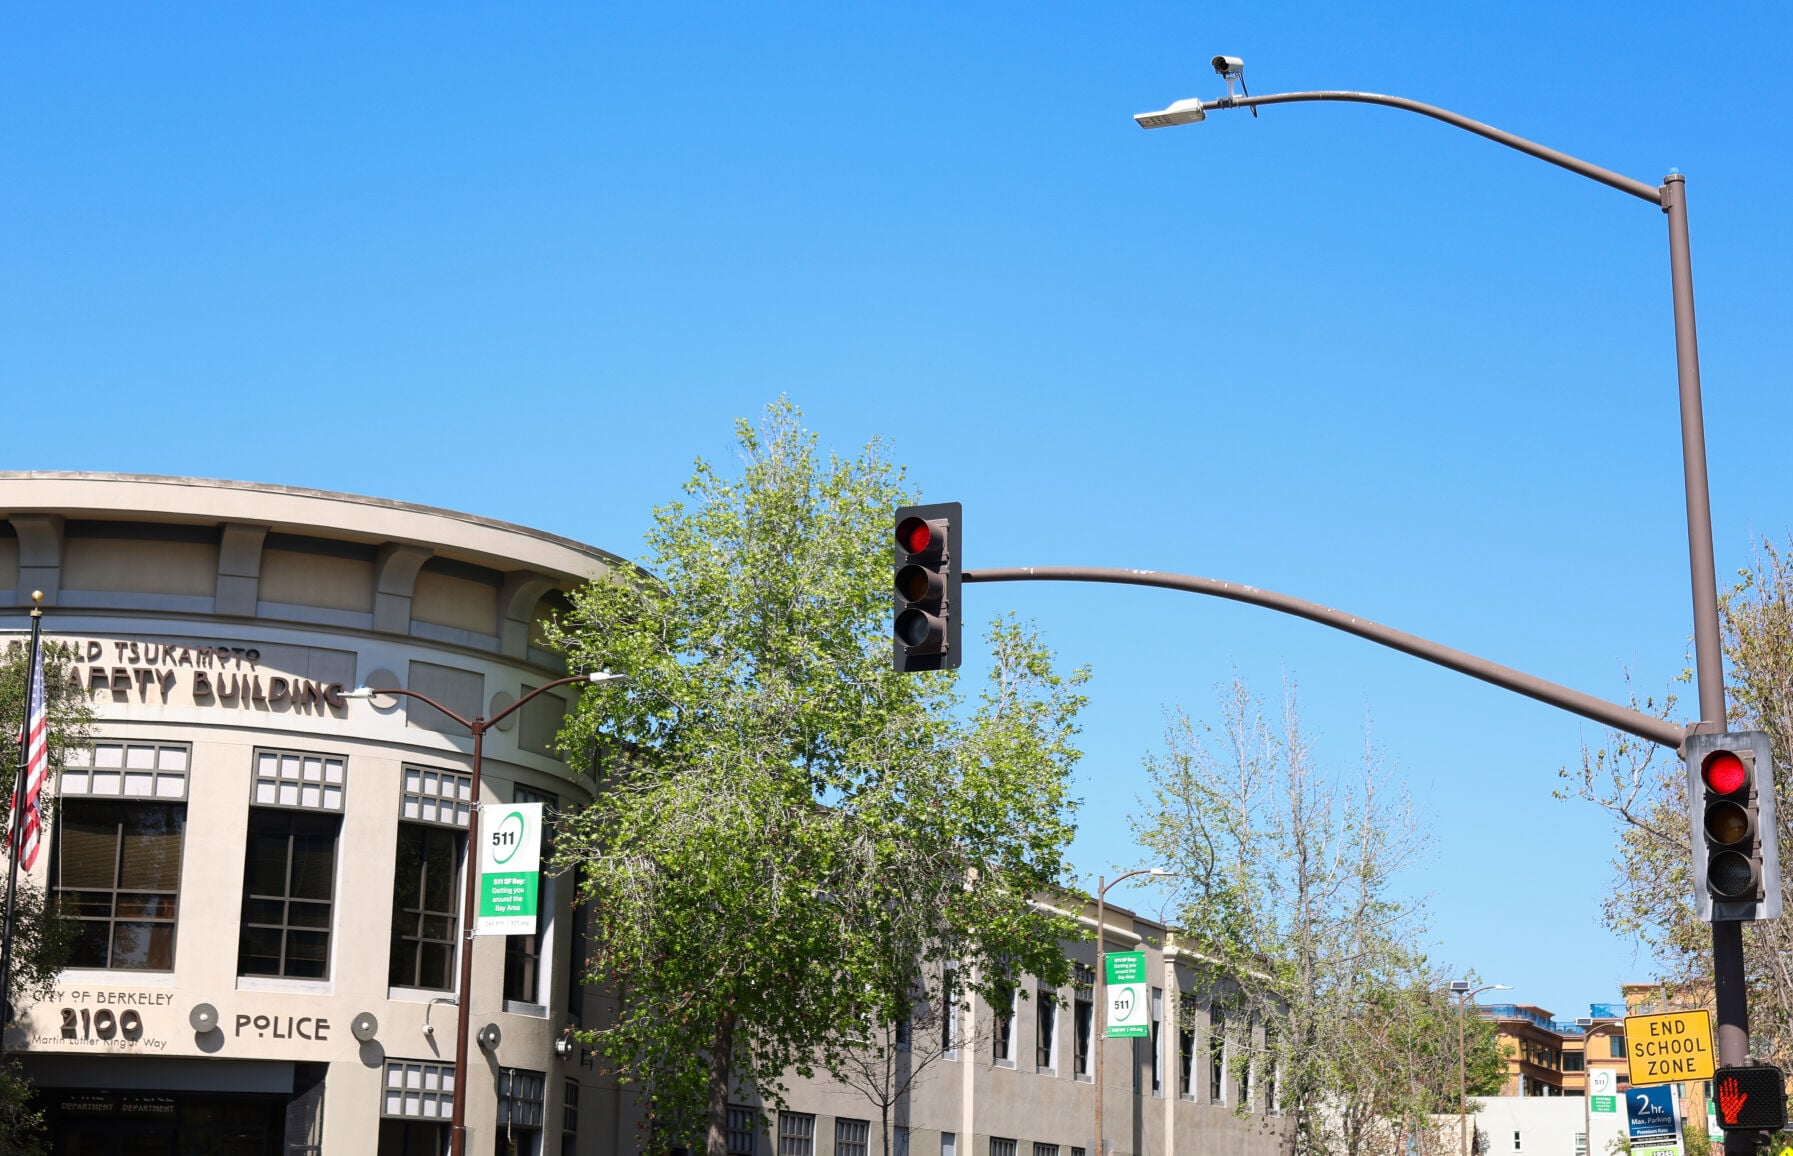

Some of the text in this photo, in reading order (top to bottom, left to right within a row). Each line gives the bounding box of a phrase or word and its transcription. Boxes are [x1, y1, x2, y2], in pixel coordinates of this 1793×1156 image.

[115, 641, 261, 671] TSUKAMOTO
[50, 666, 348, 709] AFETY BUILDING
[492, 831, 515, 846] 511
[71, 990, 91, 1003] OF
[97, 991, 174, 1006] BERKELEY
[1114, 1000, 1129, 1009] 511
[60, 1007, 142, 1034] 2100
[235, 1014, 331, 1041] POLICE
[1650, 1020, 1685, 1036] END
[31, 1036, 65, 1045] Martin
[69, 1036, 100, 1046] Luther
[103, 1037, 128, 1049] King
[143, 1038, 167, 1050] Way
[1635, 1037, 1706, 1057] SCHOOL
[1648, 1058, 1696, 1076] ZONE
[1636, 1094, 1665, 1116] 2 hr.
[1631, 1116, 1672, 1126] Max. Parking
